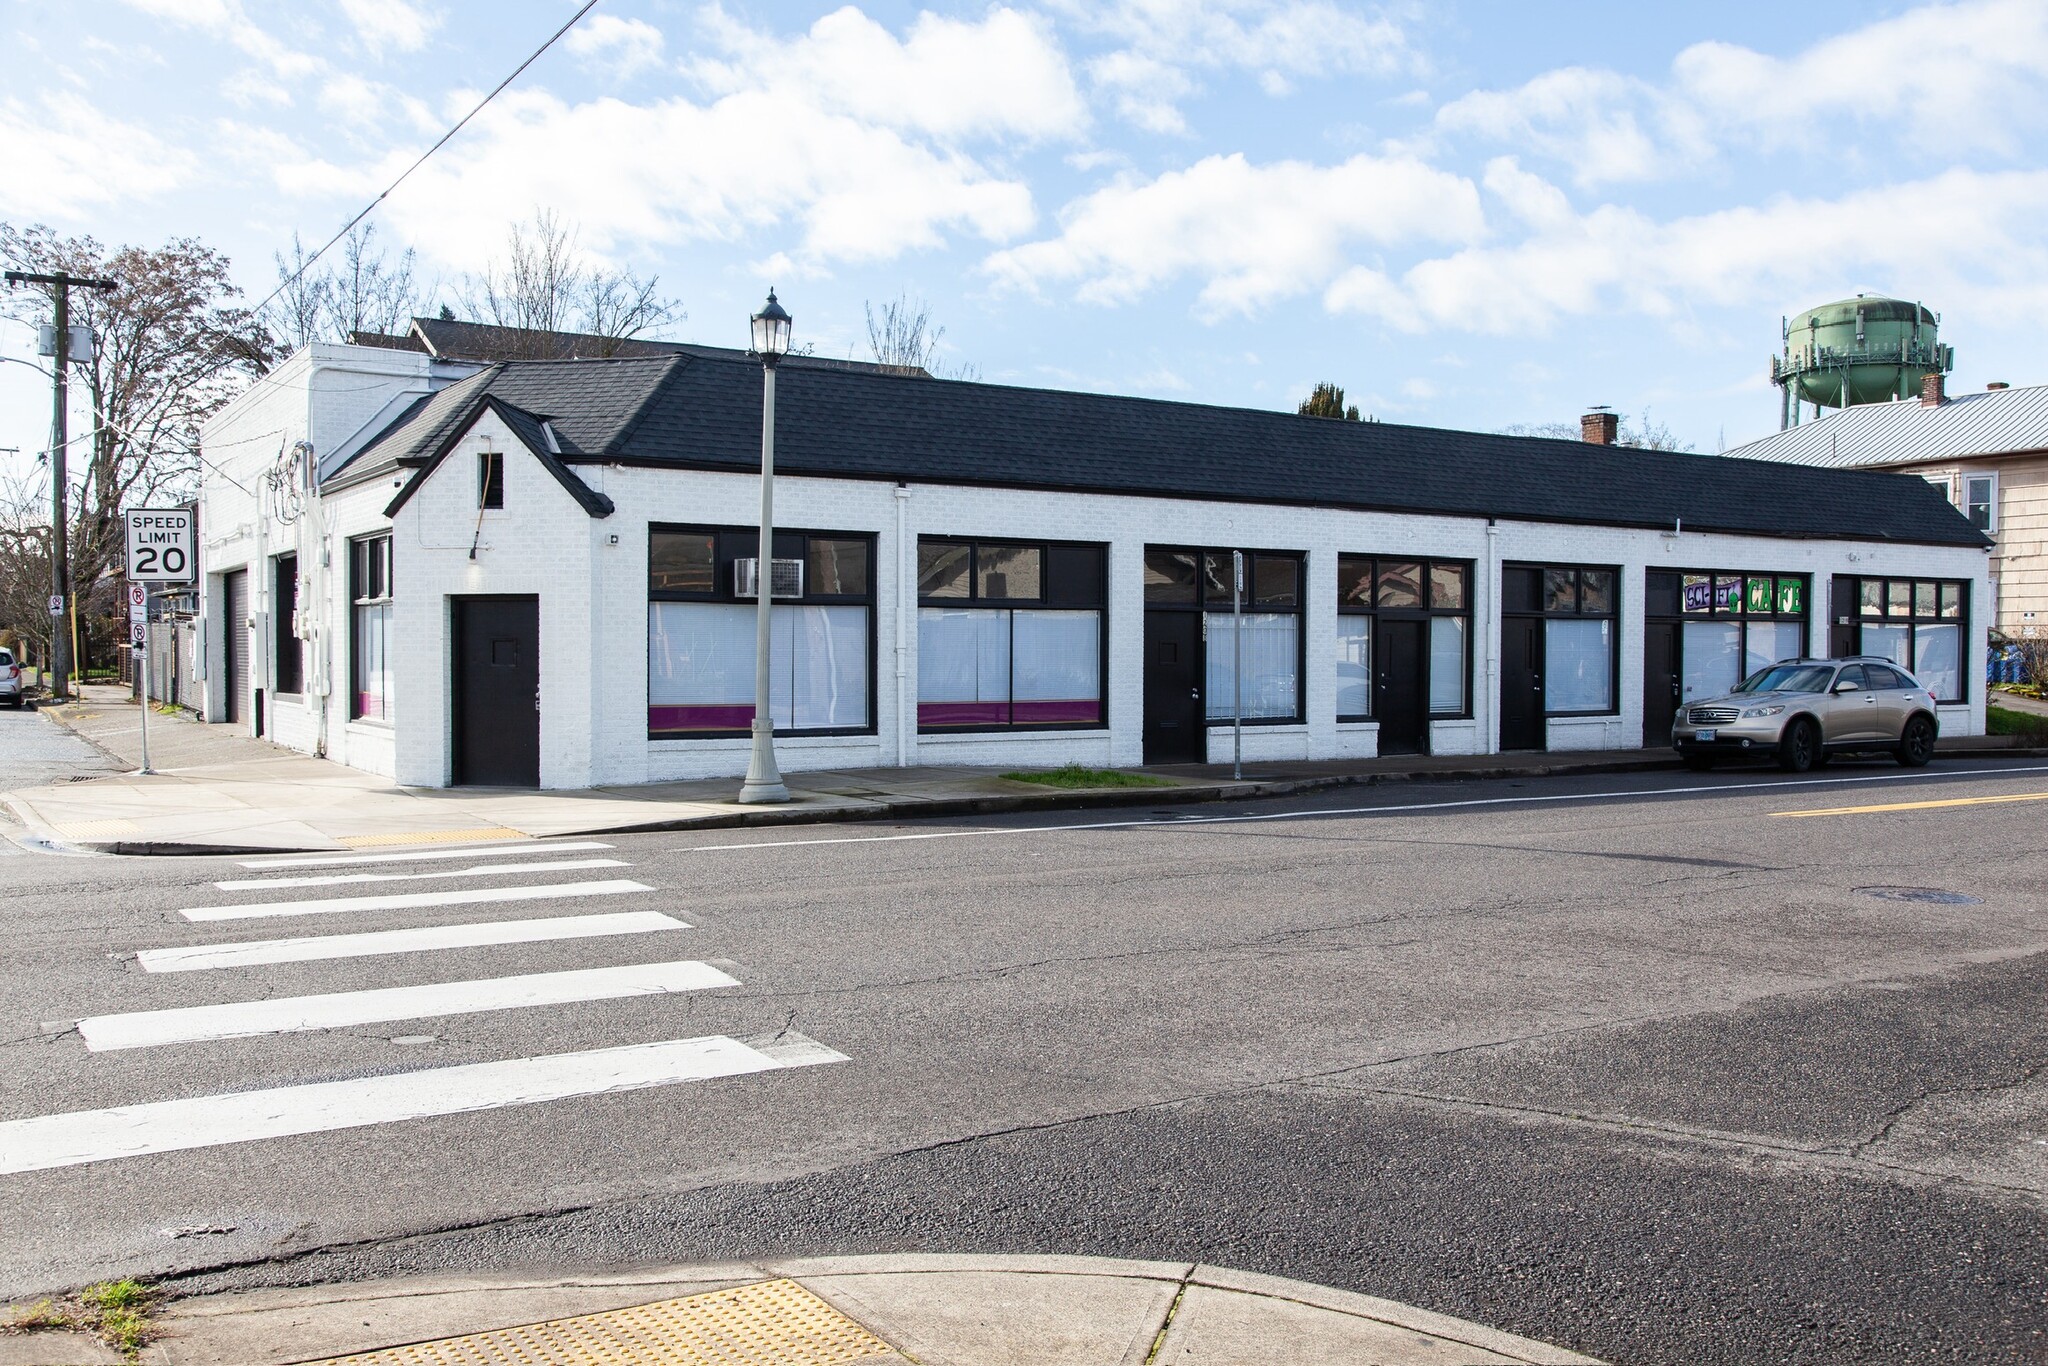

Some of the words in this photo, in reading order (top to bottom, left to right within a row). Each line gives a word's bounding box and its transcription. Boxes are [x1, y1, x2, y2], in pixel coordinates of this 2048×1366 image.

[132, 517, 187, 529] SPEED
[138, 532, 181, 544] LIMIT
[135, 547, 186, 573] 20
[1746, 579, 1803, 612] CAFE
